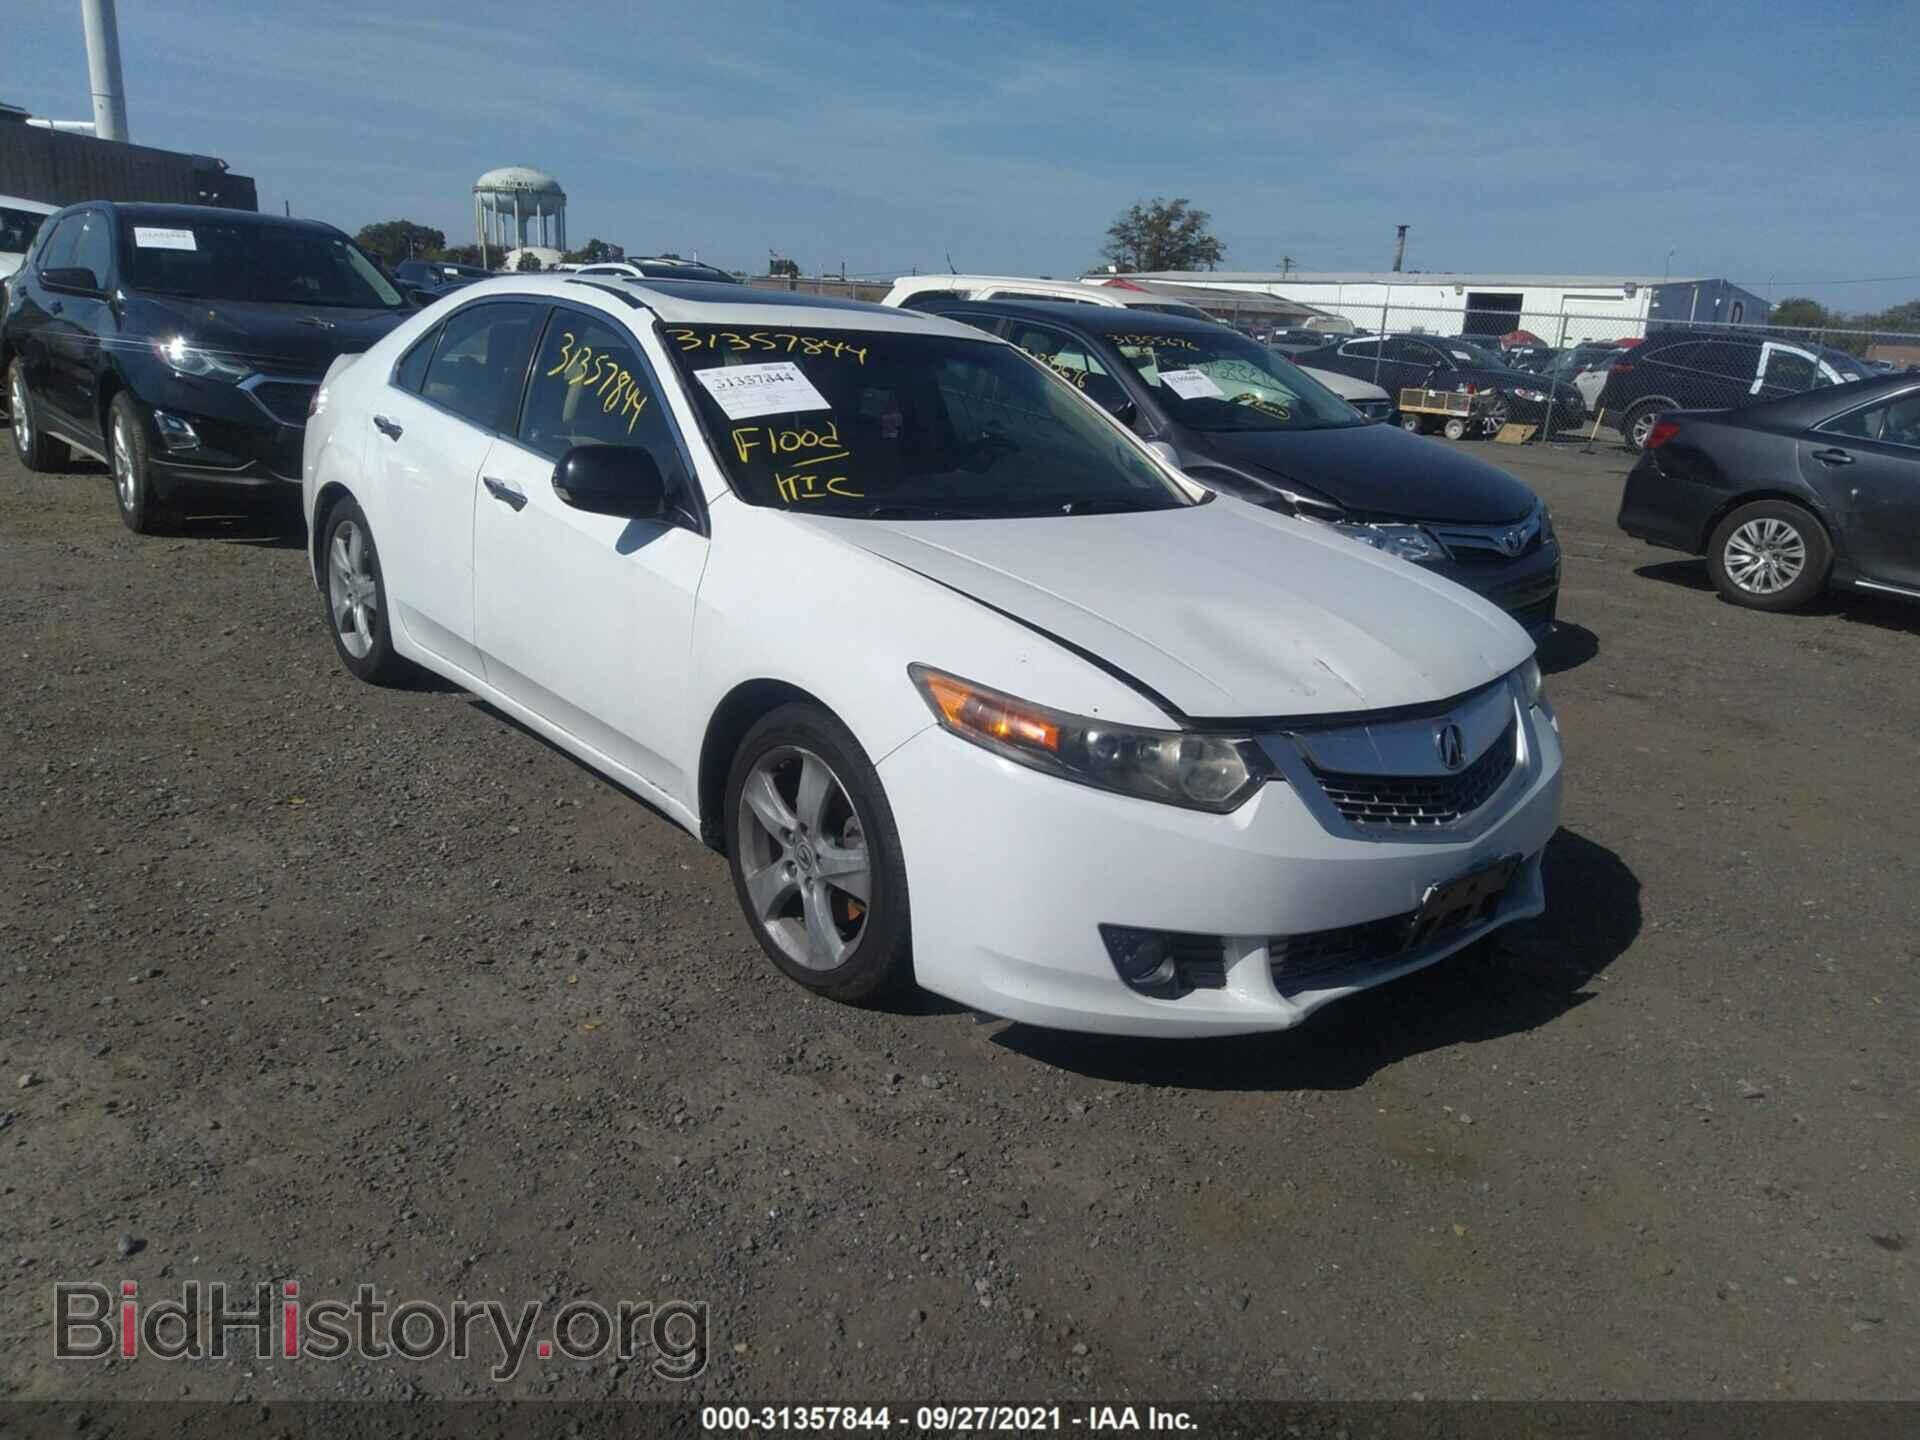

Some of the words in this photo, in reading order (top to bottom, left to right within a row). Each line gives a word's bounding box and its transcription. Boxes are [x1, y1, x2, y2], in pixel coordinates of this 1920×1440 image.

[665, 329, 868, 366] 31357844
[547, 332, 649, 435] 31357844
[712, 372, 795, 390] 31357844
